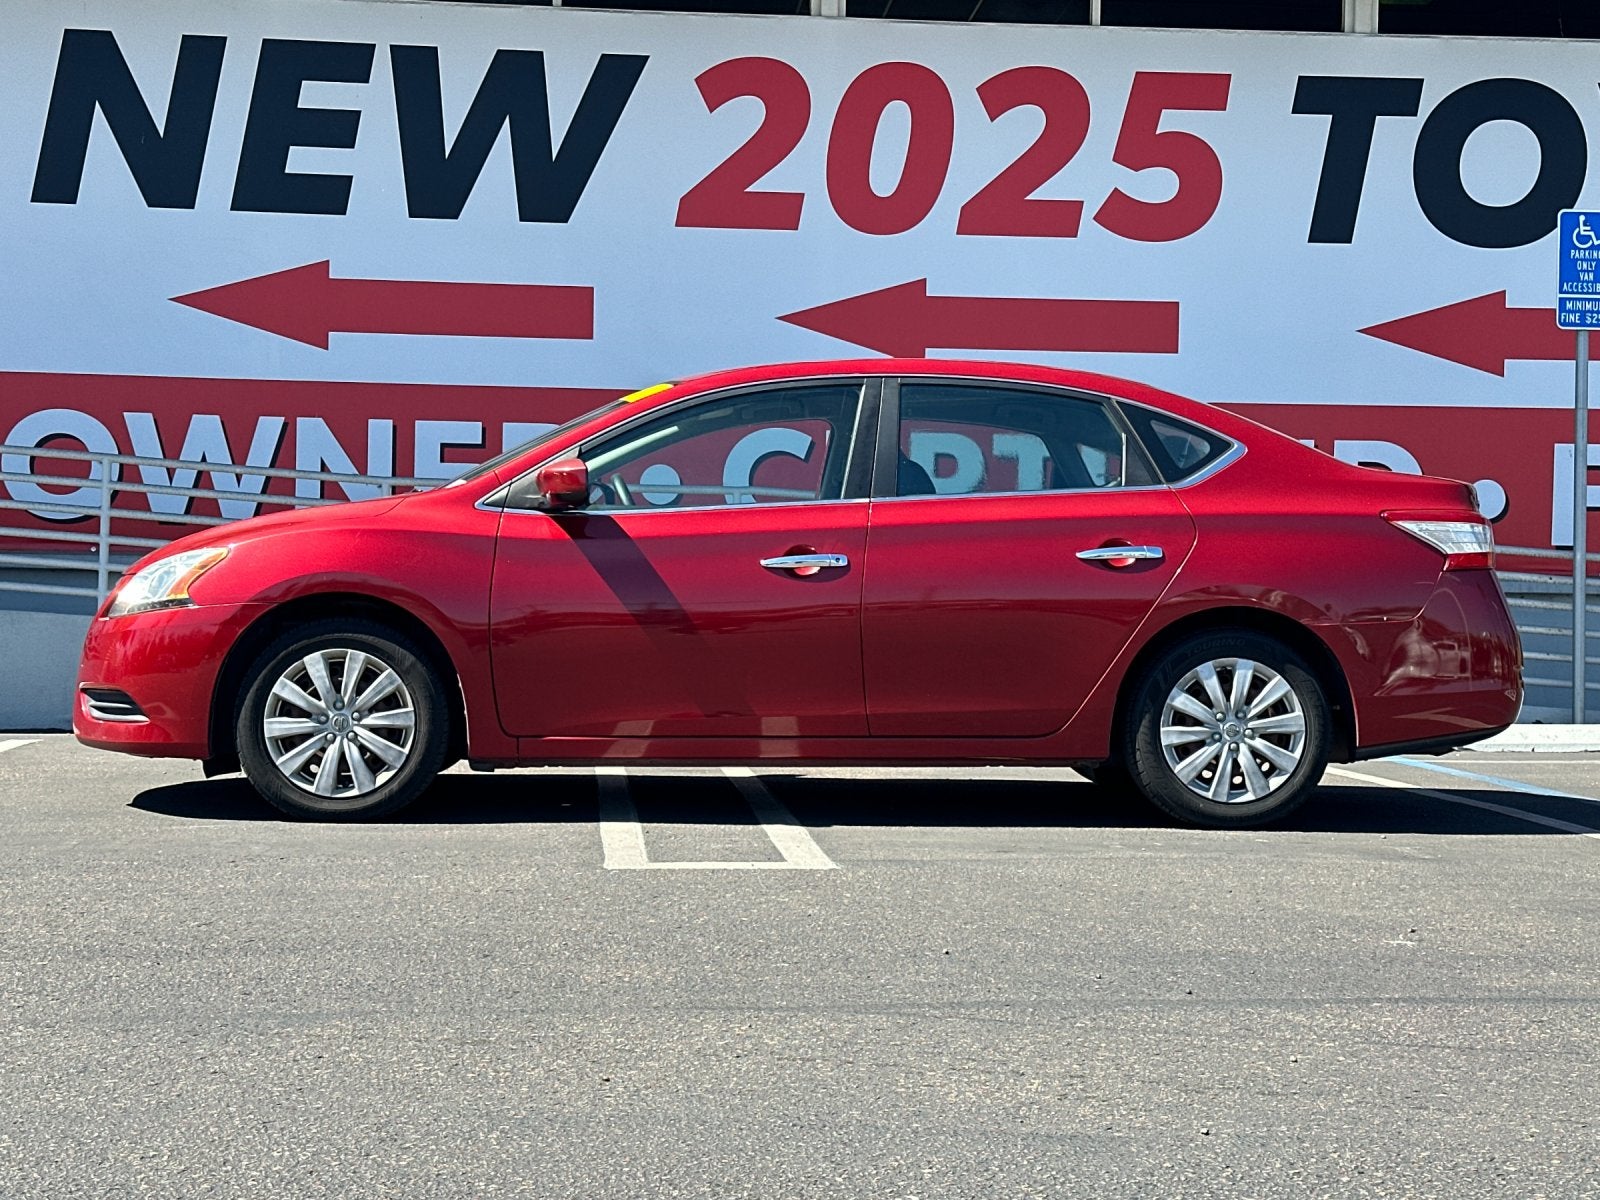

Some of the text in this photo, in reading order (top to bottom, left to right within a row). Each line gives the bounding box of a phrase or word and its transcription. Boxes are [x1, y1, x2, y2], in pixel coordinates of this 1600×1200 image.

[31, 29, 1600, 249] NEW 2025 TO
[1570, 249, 1600, 259] PARKIN
[1577, 261, 1596, 270] ONLY
[1580, 272, 1594, 281] VAN
[1566, 300, 1600, 311] MINIMU
[1561, 313, 1580, 323] FINE
